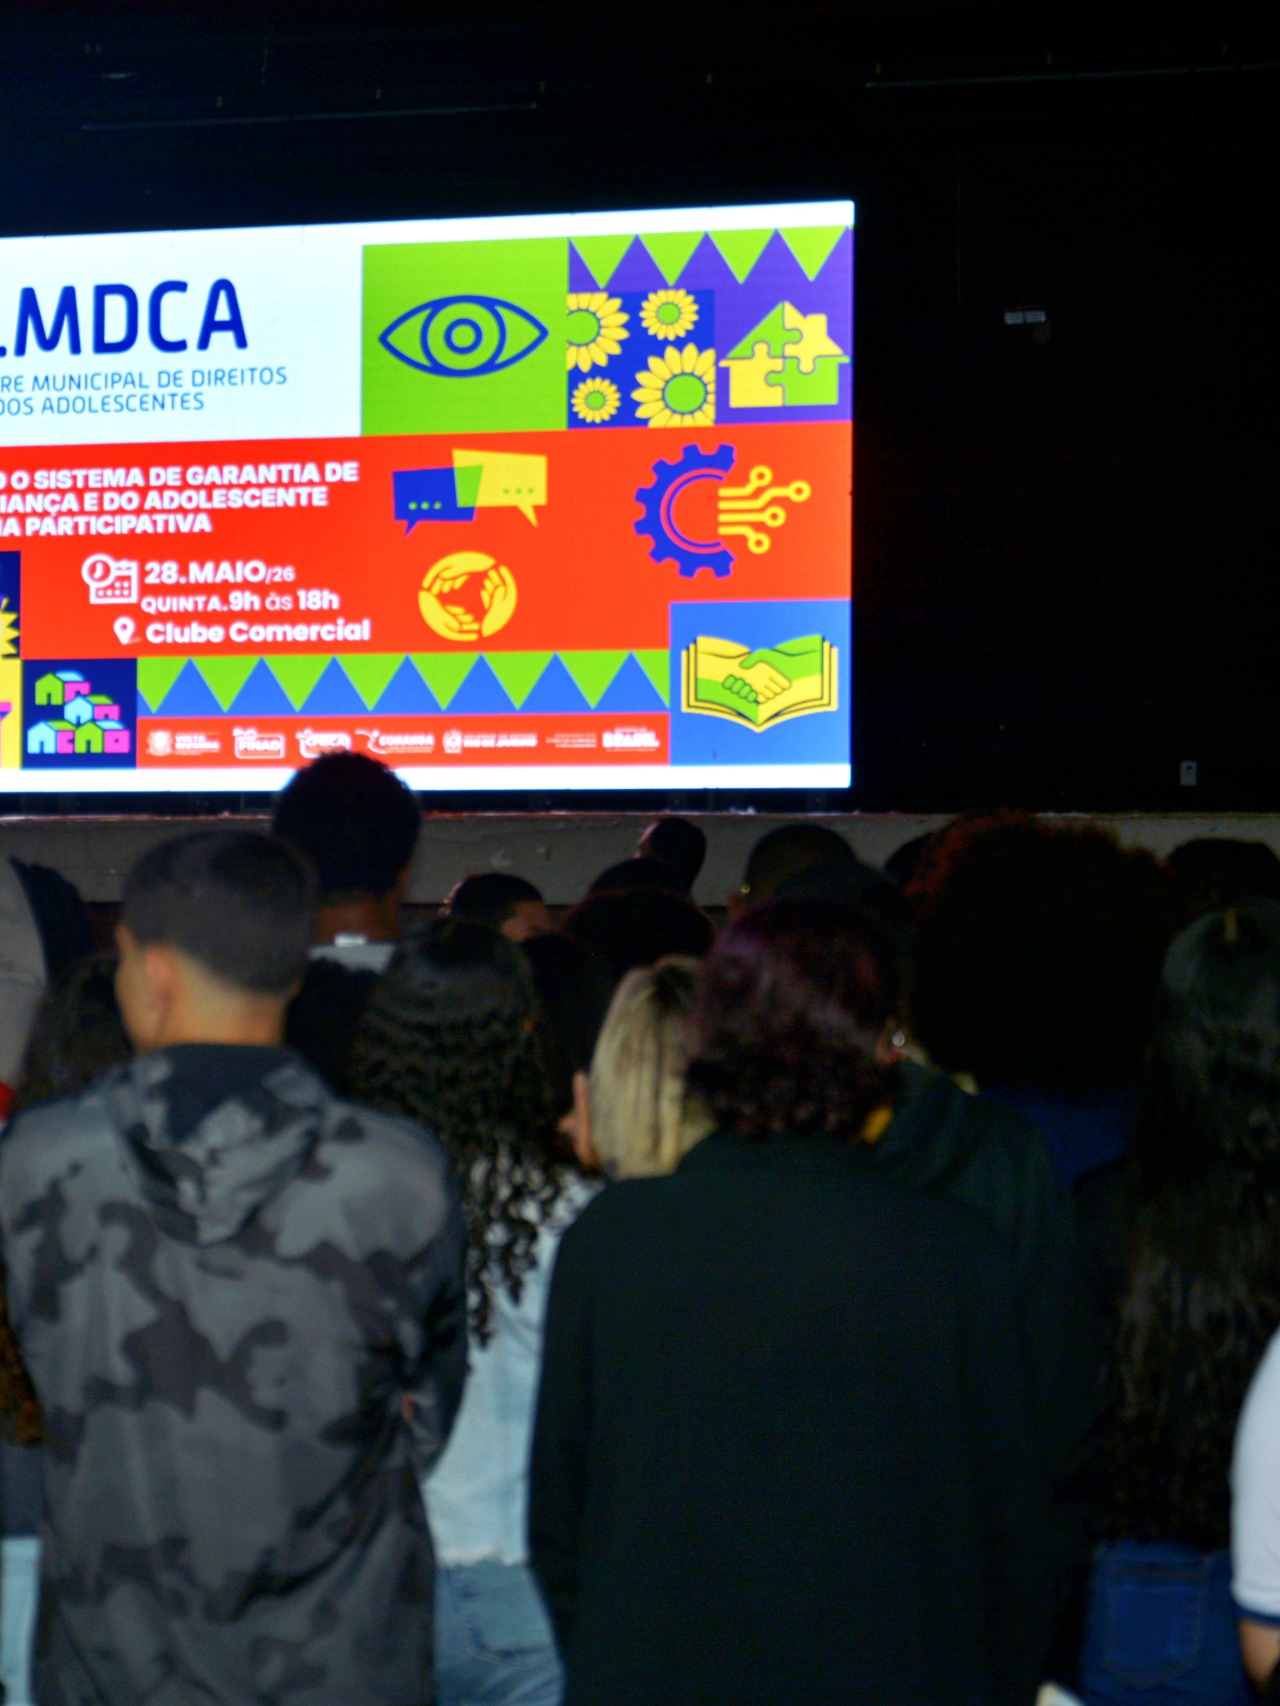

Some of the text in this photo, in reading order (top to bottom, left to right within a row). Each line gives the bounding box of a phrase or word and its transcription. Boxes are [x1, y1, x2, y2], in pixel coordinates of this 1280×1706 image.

[31, 370, 150, 393] MUNICIPAL
[157, 369, 184, 389] DE
[191, 365, 288, 388] DIREITOS
[40, 391, 205, 415] ADOLESCENTES
[10, 470, 30, 490] O
[33, 467, 145, 490] SISTEMA
[149, 466, 182, 487] DE
[185, 462, 321, 486] GARANTIA
[324, 461, 359, 483] DE
[83, 491, 99, 512] E
[103, 490, 140, 511] DO
[143, 485, 328, 510] ADOLESCENTE
[25, 512, 212, 537] PARTICIPATIVA
[265, 592, 293, 612] às
[296, 589, 340, 611] 18h
[145, 617, 371, 644] Clube Comercial
